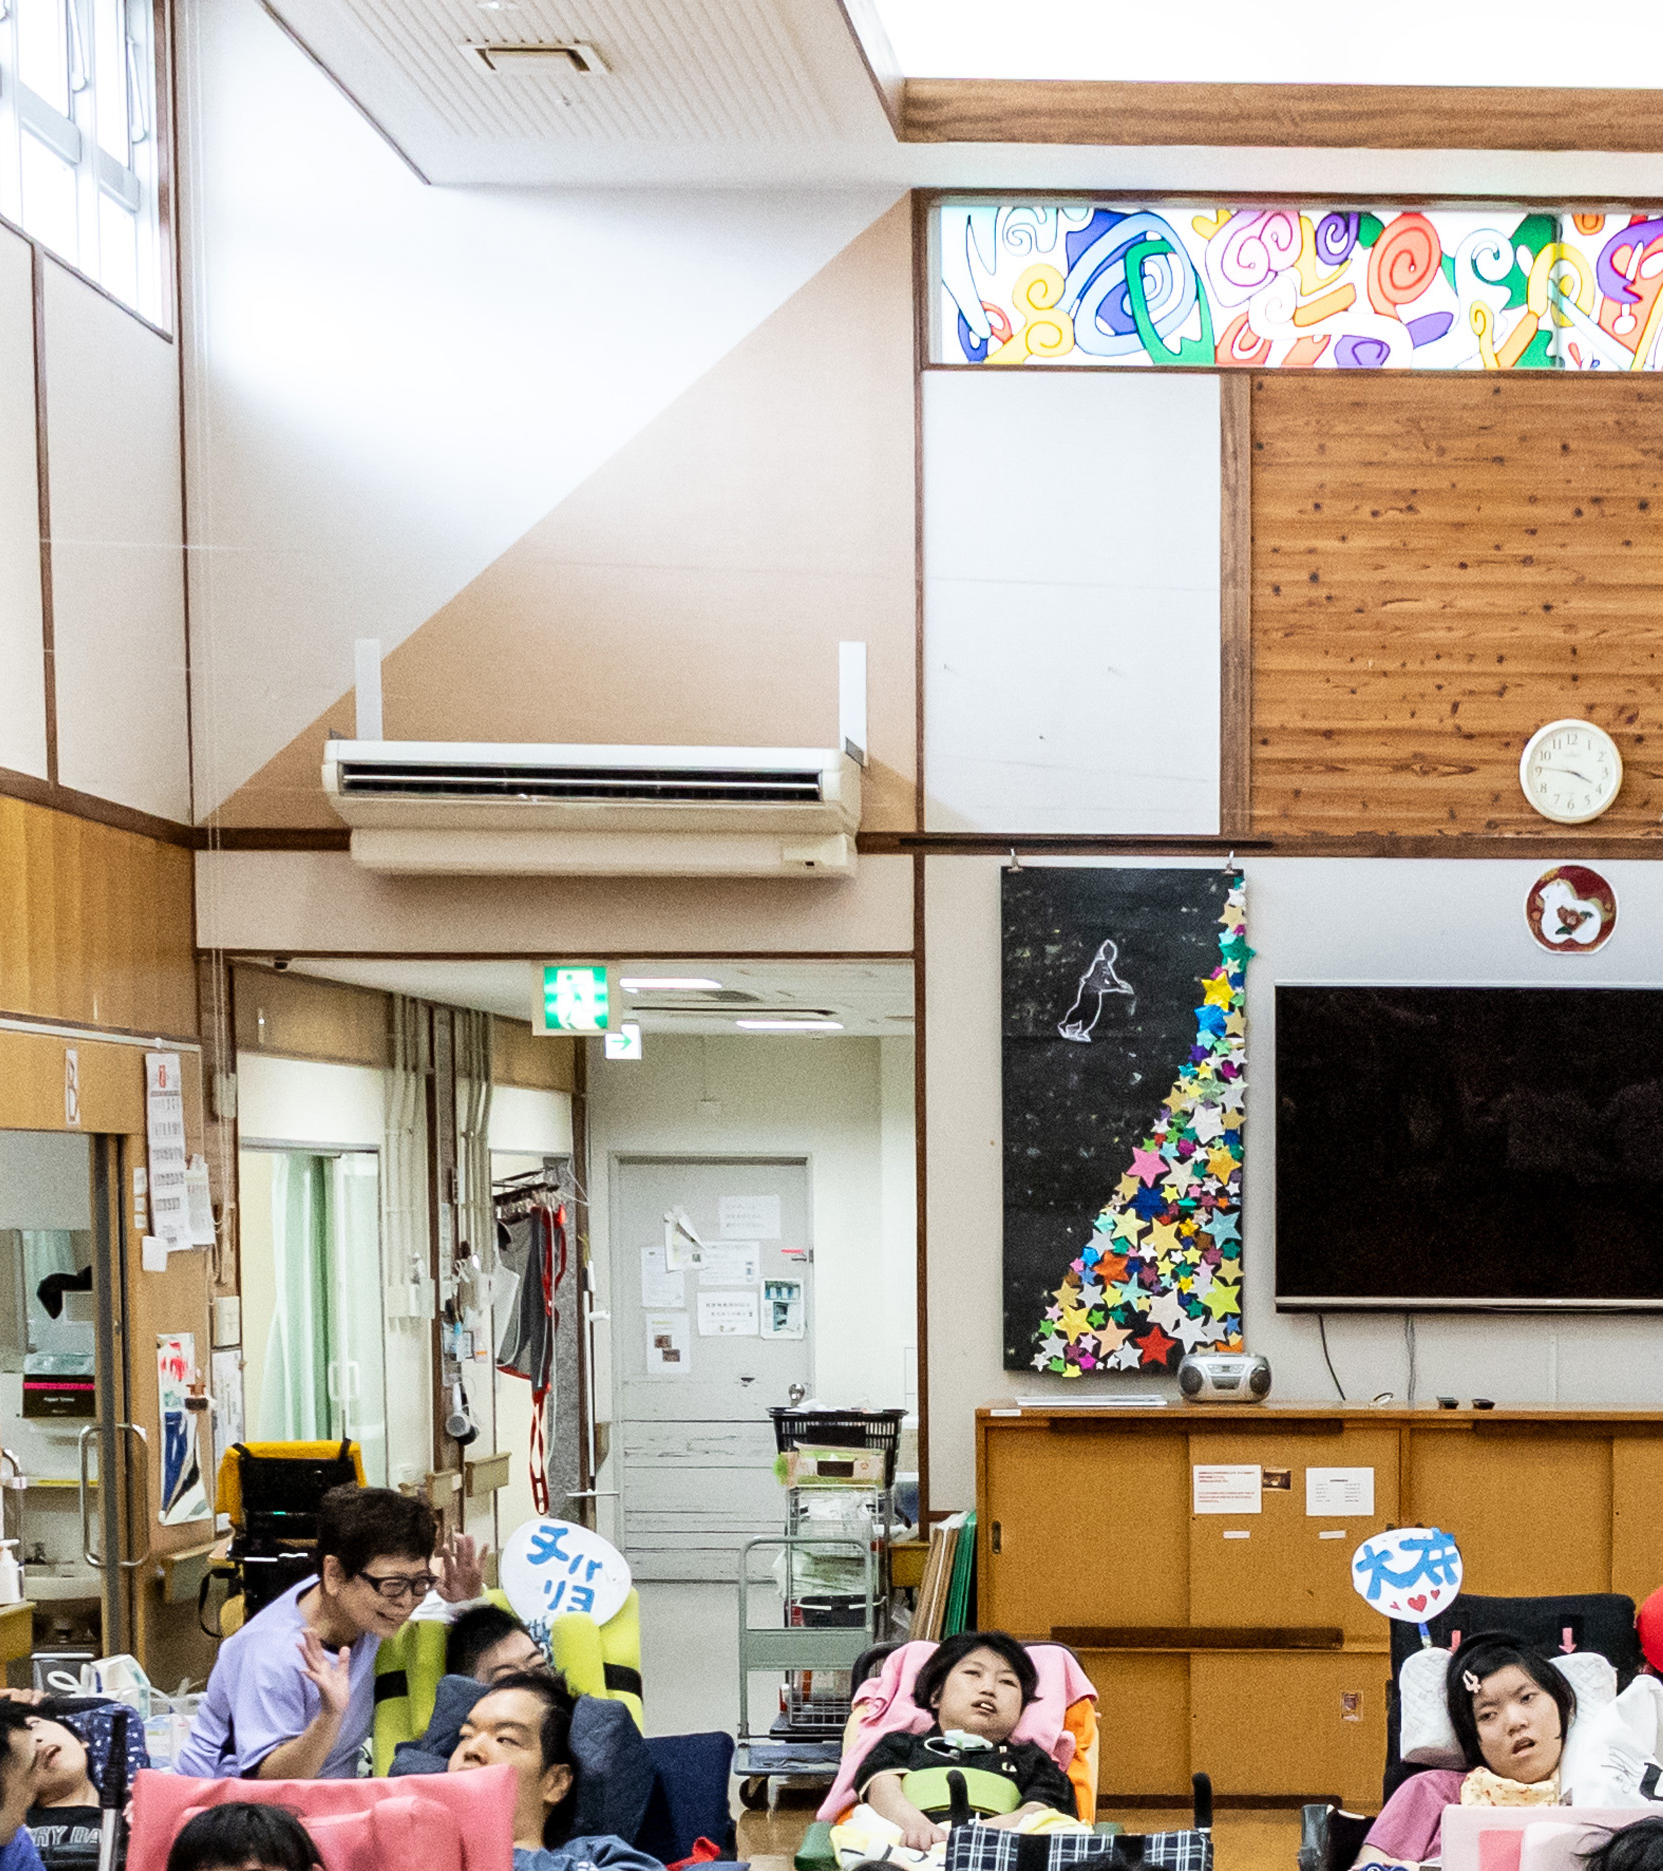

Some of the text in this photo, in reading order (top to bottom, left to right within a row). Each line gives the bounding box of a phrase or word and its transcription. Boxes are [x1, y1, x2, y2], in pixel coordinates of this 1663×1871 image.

[1552, 739, 1562, 750] 11
[1567, 734, 1578, 745] 12
[1587, 739, 1592, 751] 1
[1540, 751, 1551, 761] 10
[1597, 752, 1605, 762] 2
[1535, 766, 1543, 776] 9
[1602, 768, 1609, 778] 3
[1539, 783, 1548, 794] 8
[1595, 783, 1602, 795] 4
[1554, 794, 1561, 804] 7
[1585, 795, 1591, 805] 5
[1567, 799, 1575, 810] 6
